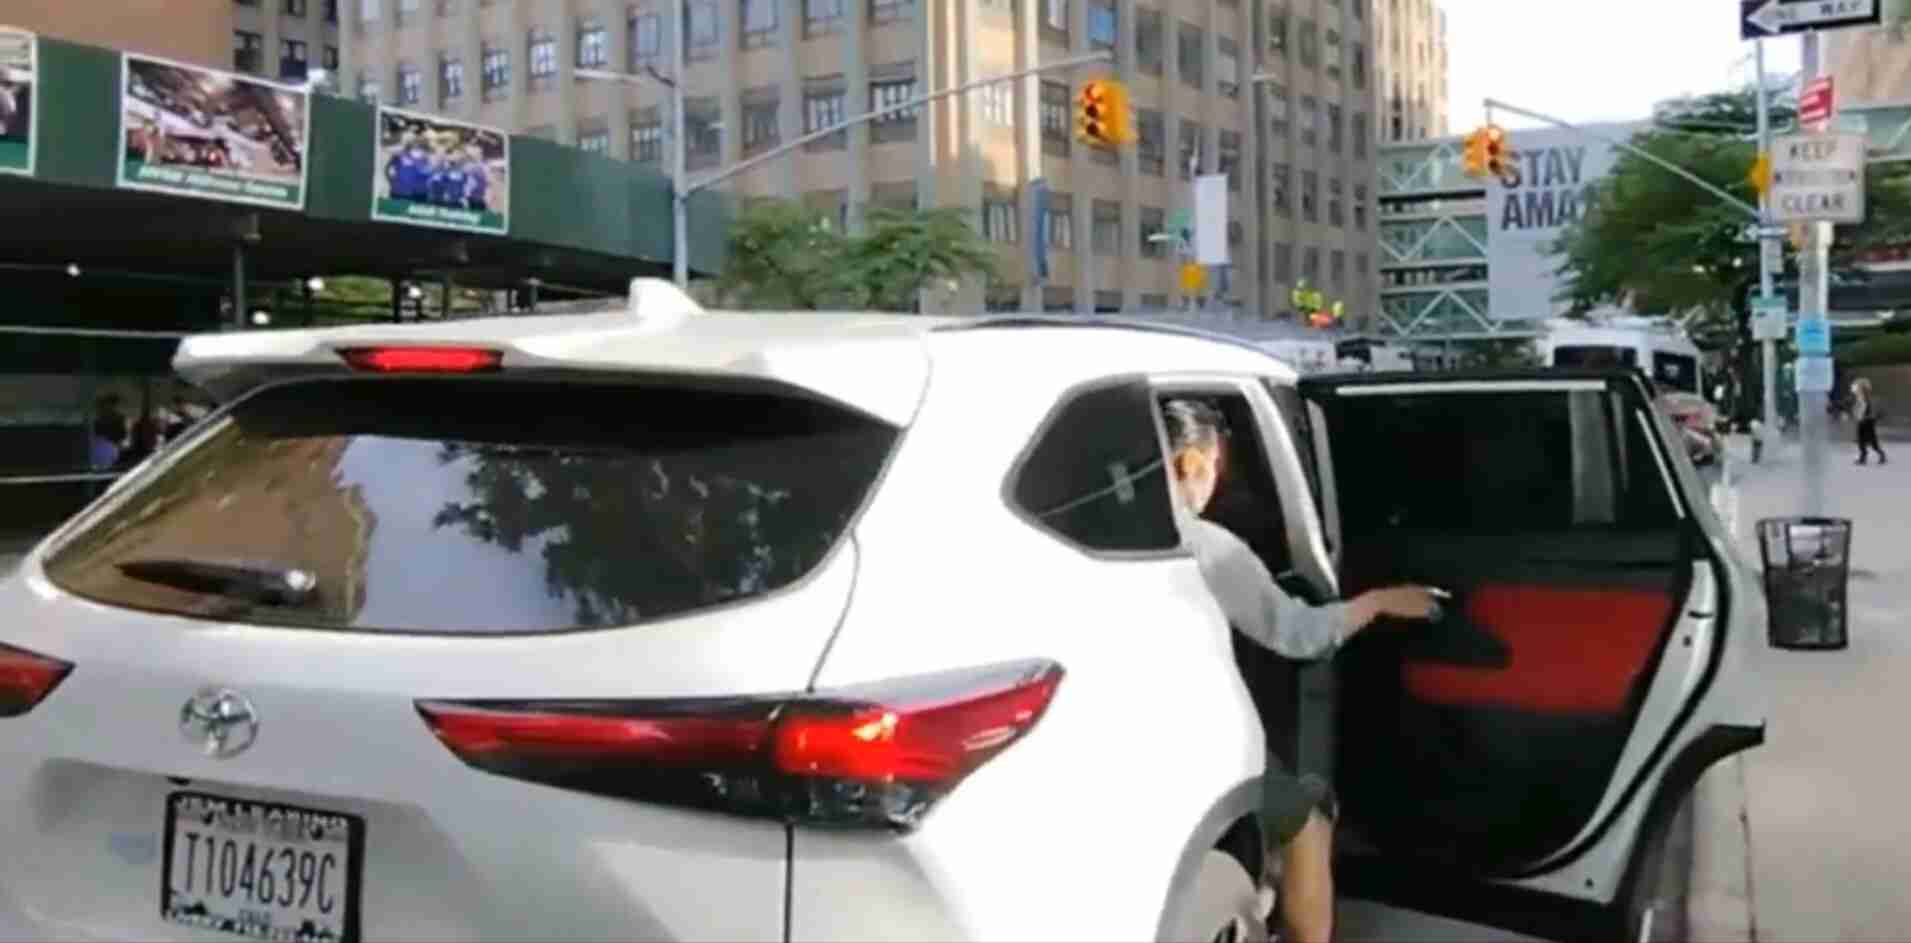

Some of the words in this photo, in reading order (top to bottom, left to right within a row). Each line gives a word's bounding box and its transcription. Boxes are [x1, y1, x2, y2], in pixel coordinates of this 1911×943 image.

[1501, 145, 1586, 189] STAY
[1780, 190, 1845, 214] CLEAR
[185, 831, 336, 915] T104639C
